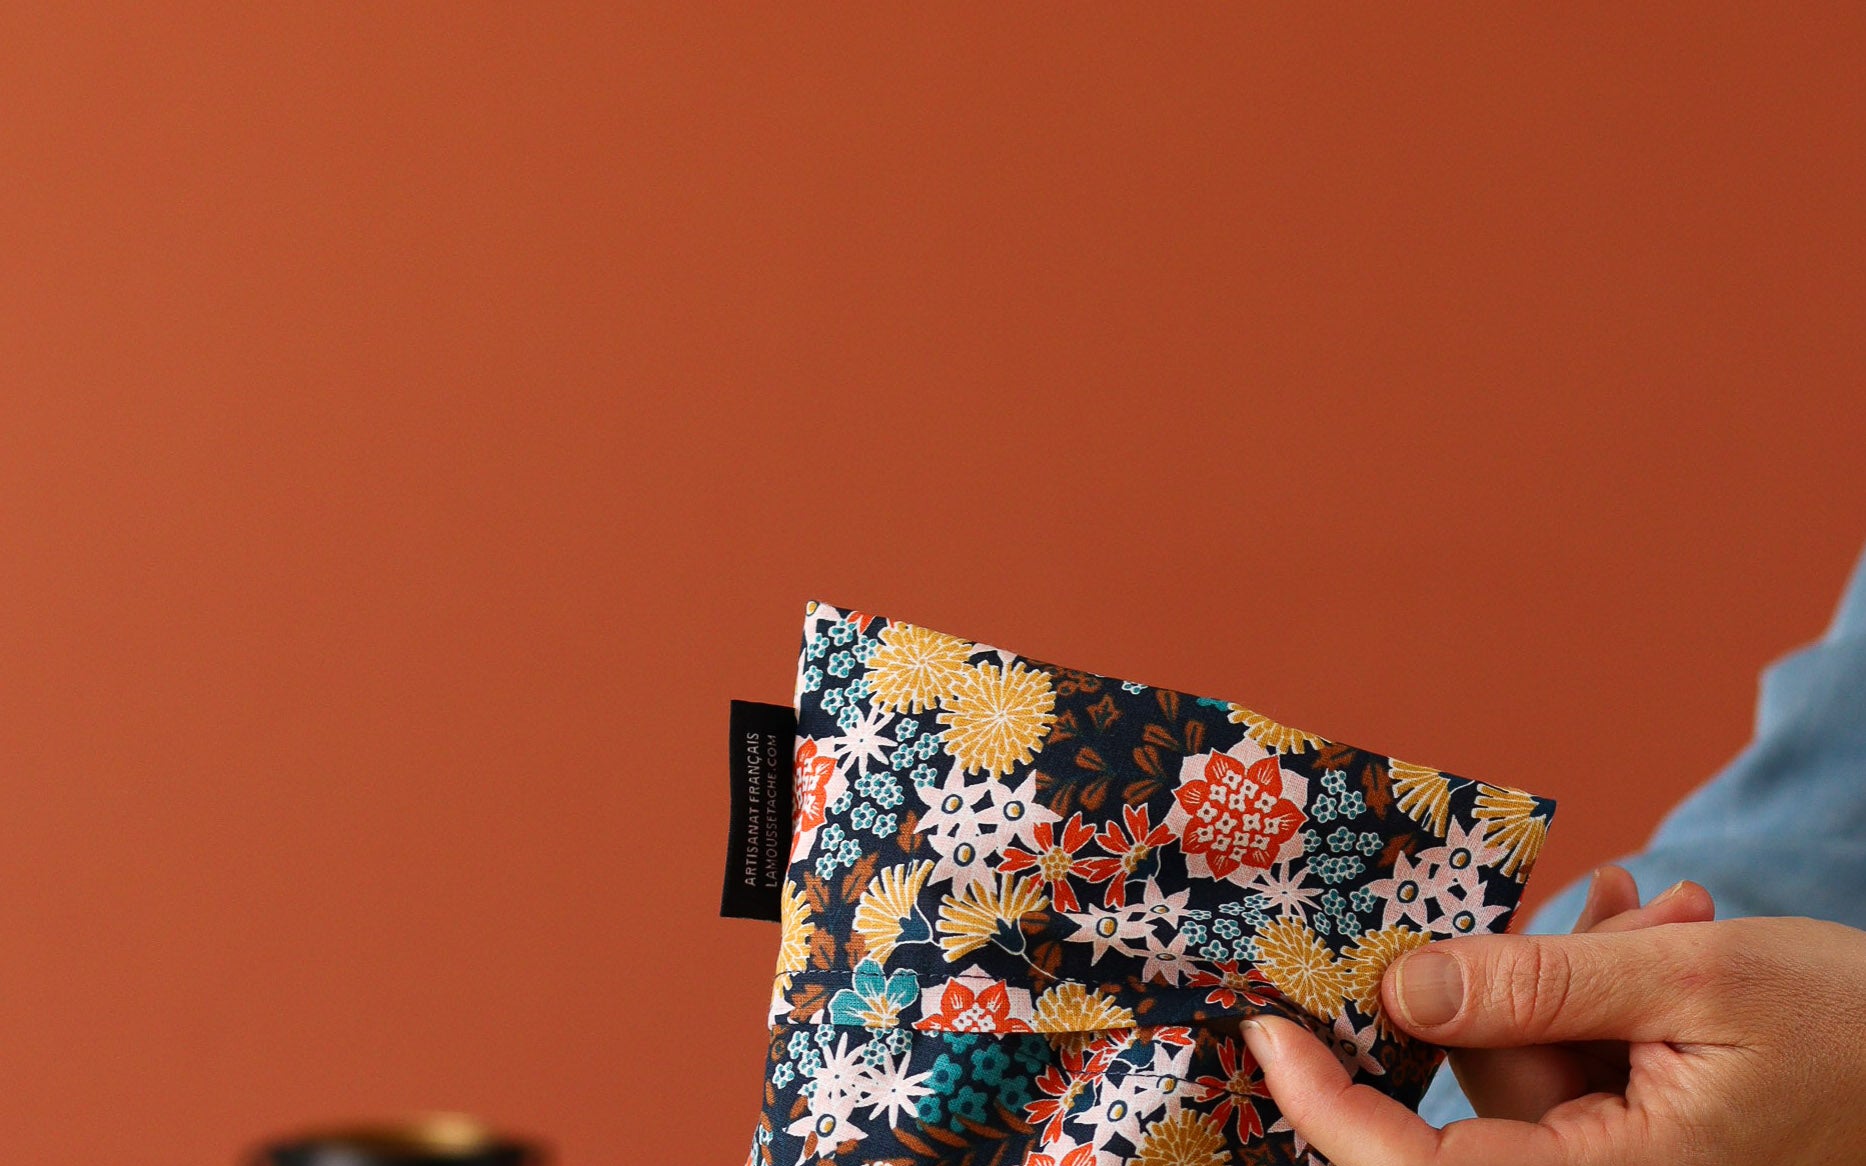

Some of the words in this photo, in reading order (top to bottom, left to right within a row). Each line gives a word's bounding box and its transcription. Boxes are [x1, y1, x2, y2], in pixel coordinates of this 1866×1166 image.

[746, 732, 761, 802] FRANÇAIS
[744, 807, 760, 886] ARTISANAT
[765, 734, 777, 888] LAMOUSSETACHE.COM
